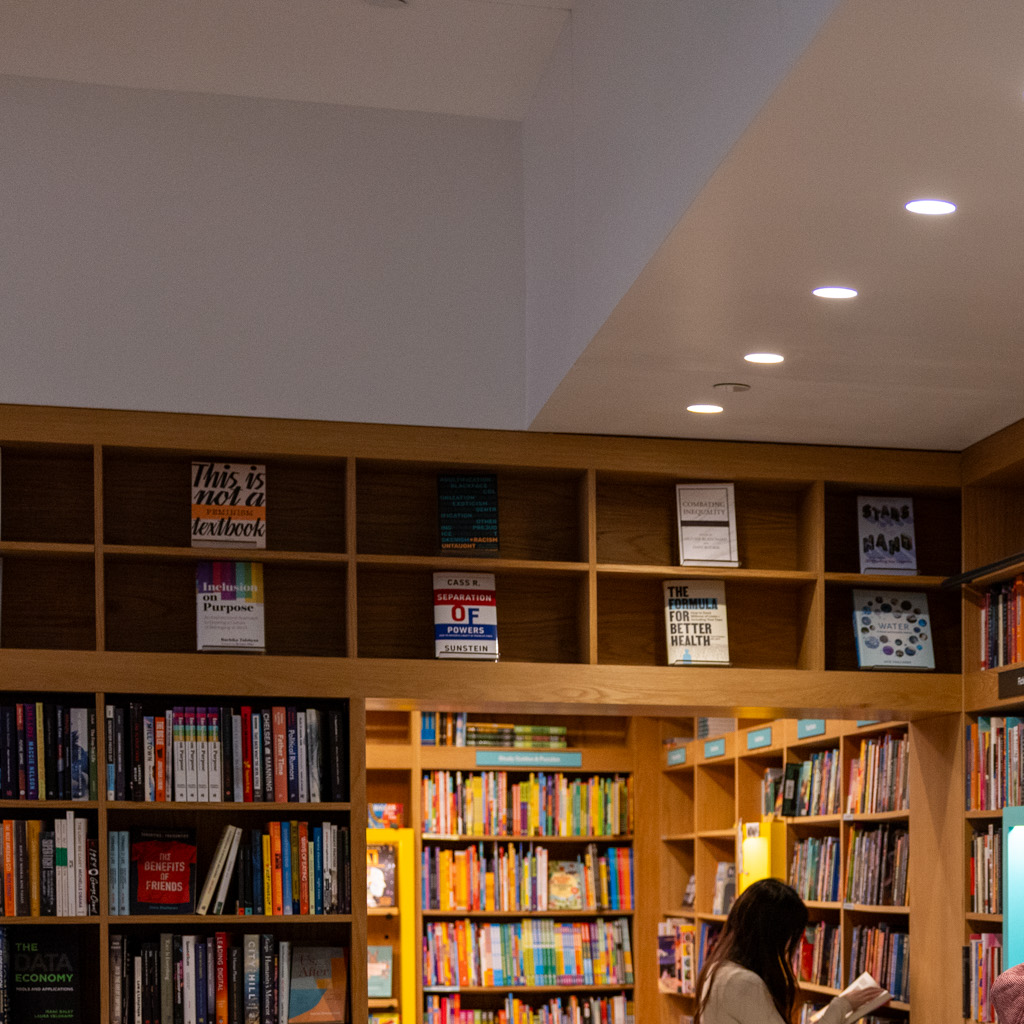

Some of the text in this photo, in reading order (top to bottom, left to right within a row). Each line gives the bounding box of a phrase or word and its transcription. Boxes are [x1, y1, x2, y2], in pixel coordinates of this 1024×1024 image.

[192, 463, 265, 490] This is
[193, 486, 265, 507] not a
[192, 517, 266, 538] textbook
[203, 582, 258, 592] Inclusion
[447, 579, 471, 587] CASS
[668, 586, 689, 598] THE
[203, 594, 218, 602] on
[437, 594, 492, 602] SEPARATION
[203, 603, 254, 613] Purpose
[668, 598, 718, 610] FORMULA
[451, 604, 480, 625] OF
[670, 611, 690, 622] FOR
[447, 626, 484, 634] POWERS
[670, 623, 712, 634] BETTER
[878, 623, 910, 631] WATER
[671, 635, 711, 647] HEALTH
[445, 645, 488, 653] SUNSTEIN
[159, 853, 171, 862] THE
[144, 862, 185, 872] BENEFITS
[160, 872, 170, 881] OF
[146, 881, 183, 892] FRIENDS
[15, 942, 39, 951] THE
[15, 953, 74, 972] DATA
[15, 974, 74, 983] ECONOMY
